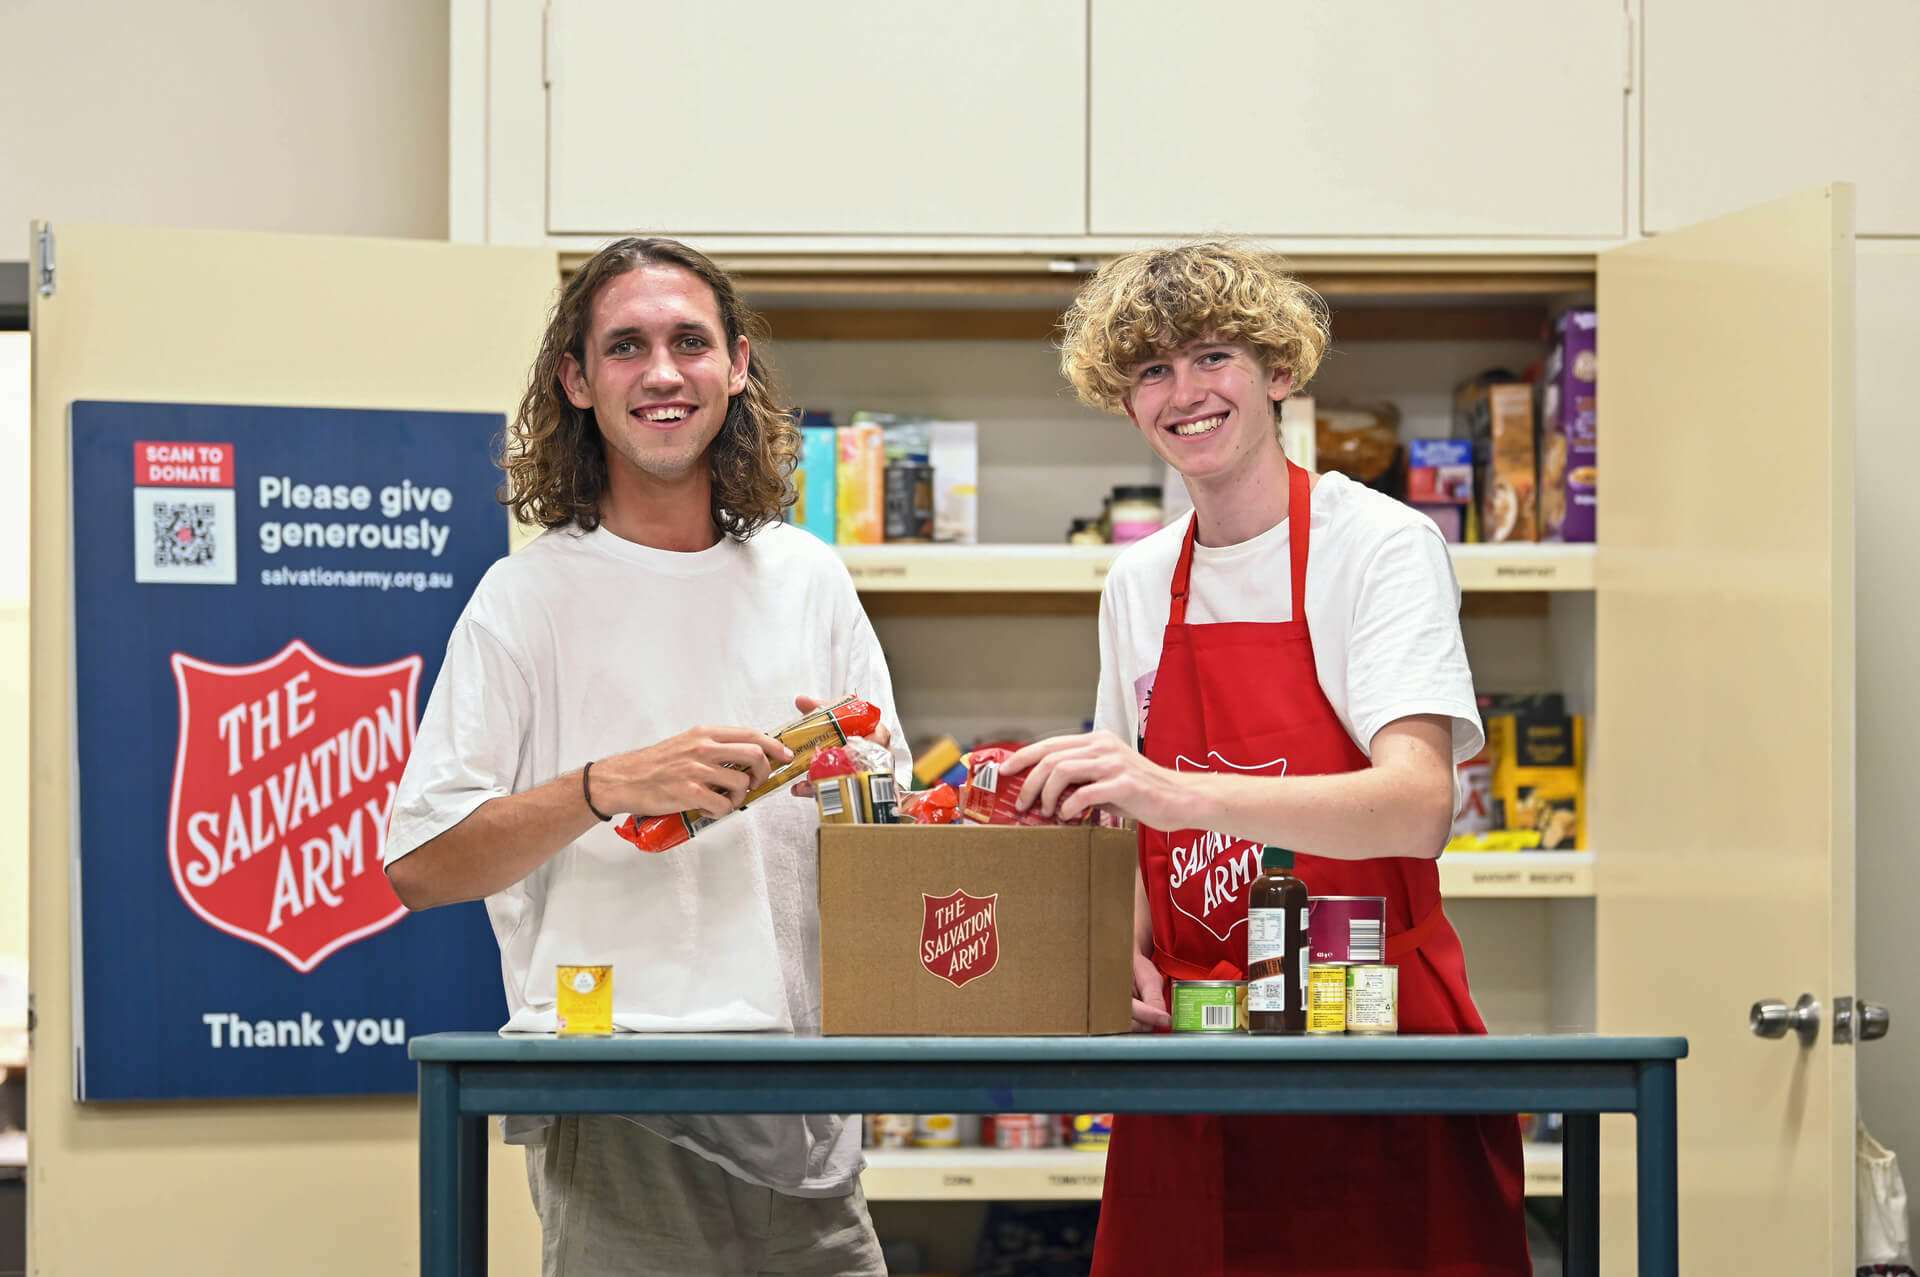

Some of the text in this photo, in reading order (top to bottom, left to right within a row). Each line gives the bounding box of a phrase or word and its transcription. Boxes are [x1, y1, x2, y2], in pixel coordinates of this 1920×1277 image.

[145, 445, 224, 467] SCAN TO
[148, 463, 222, 484] DONATE
[259, 475, 453, 520] Please give
[259, 517, 451, 556] generously
[260, 565, 453, 592] salvationarmy.org.au
[218, 671, 317, 777] THE
[185, 688, 404, 888] SALVATION
[266, 780, 397, 934] ARMY
[1169, 830, 1242, 889] SALVA
[1202, 843, 1267, 918] ARMY
[923, 902, 993, 964] SALVATION
[934, 896, 966, 931] THE
[947, 931, 990, 977] ARMY
[203, 1011, 406, 1054] Thank you
